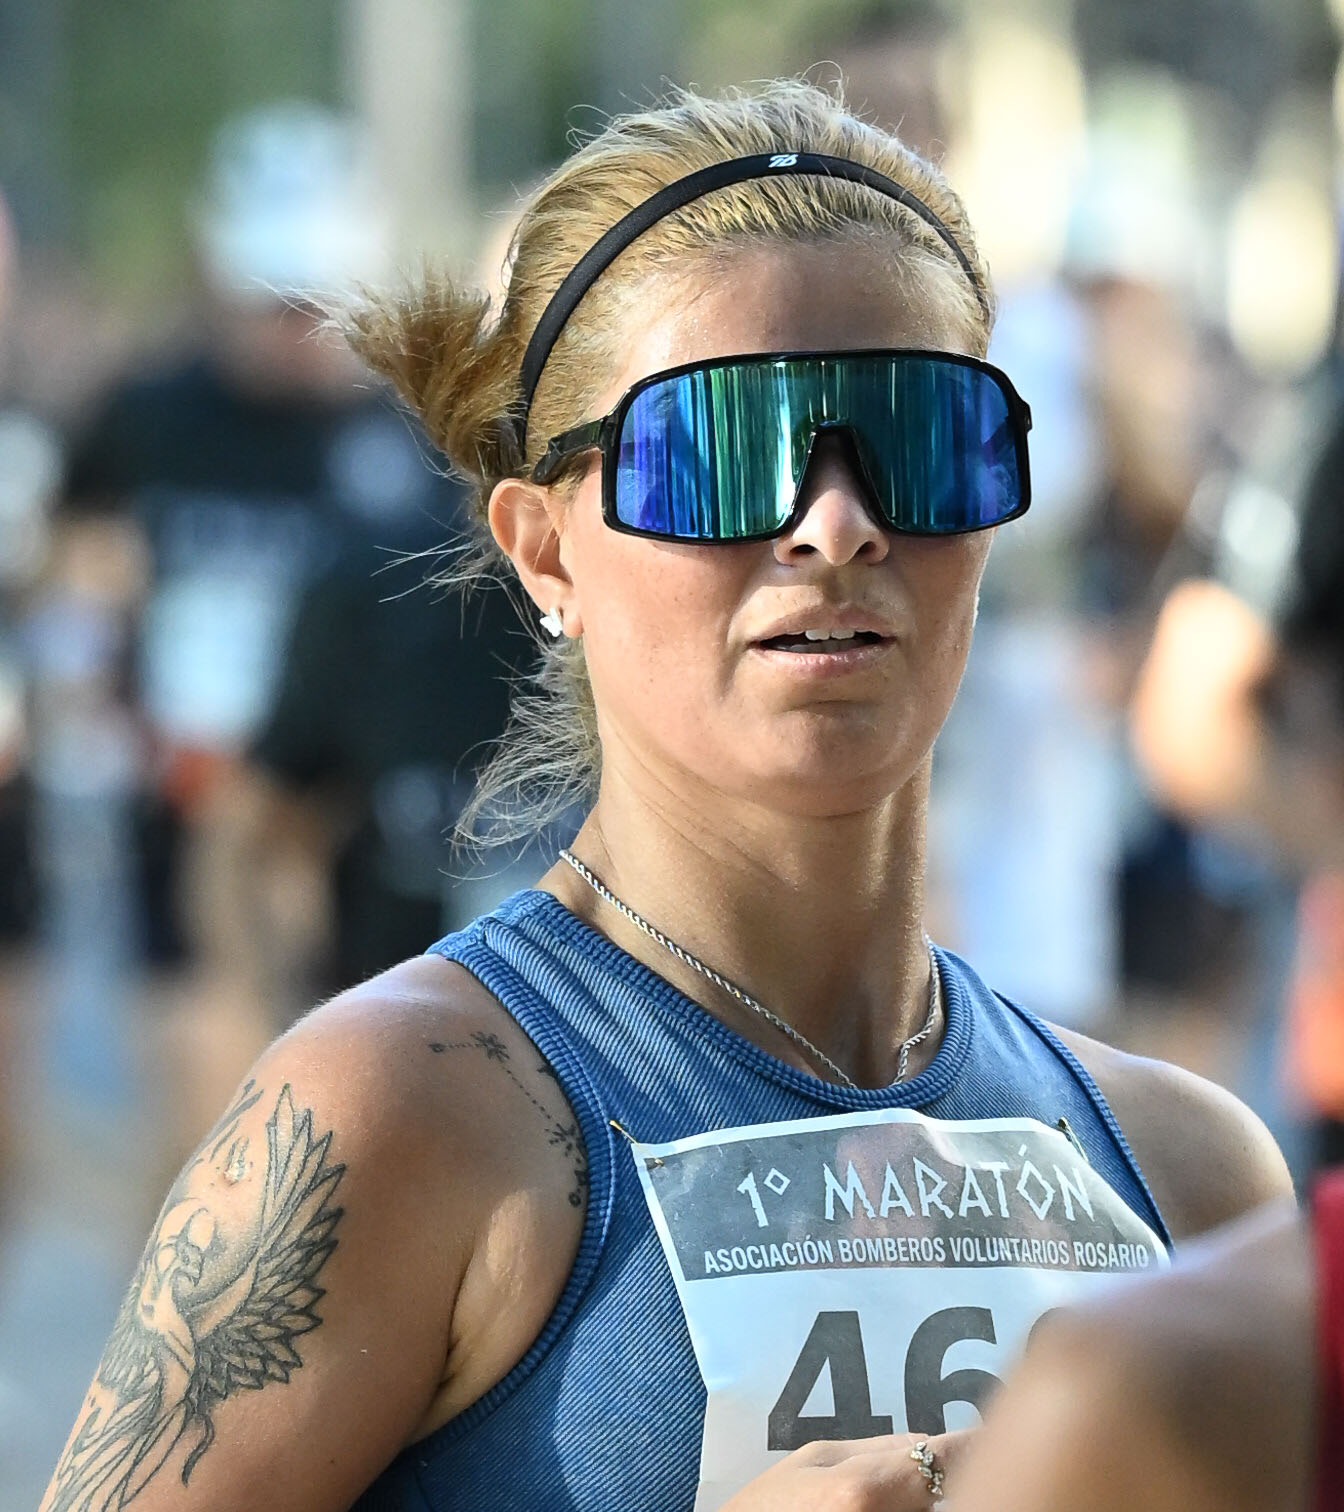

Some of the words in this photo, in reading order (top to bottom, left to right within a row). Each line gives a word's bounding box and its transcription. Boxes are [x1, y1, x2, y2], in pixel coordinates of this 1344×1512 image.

[823, 1143, 1095, 1222] MARATÓN
[704, 1234, 834, 1274] ASOCIACIÓN
[840, 1236, 946, 1265] BOMBEROS
[953, 1236, 1069, 1267] VOLUNTARIOS
[1073, 1240, 1149, 1270] ROSARIO
[767, 1305, 1060, 1452] 46
